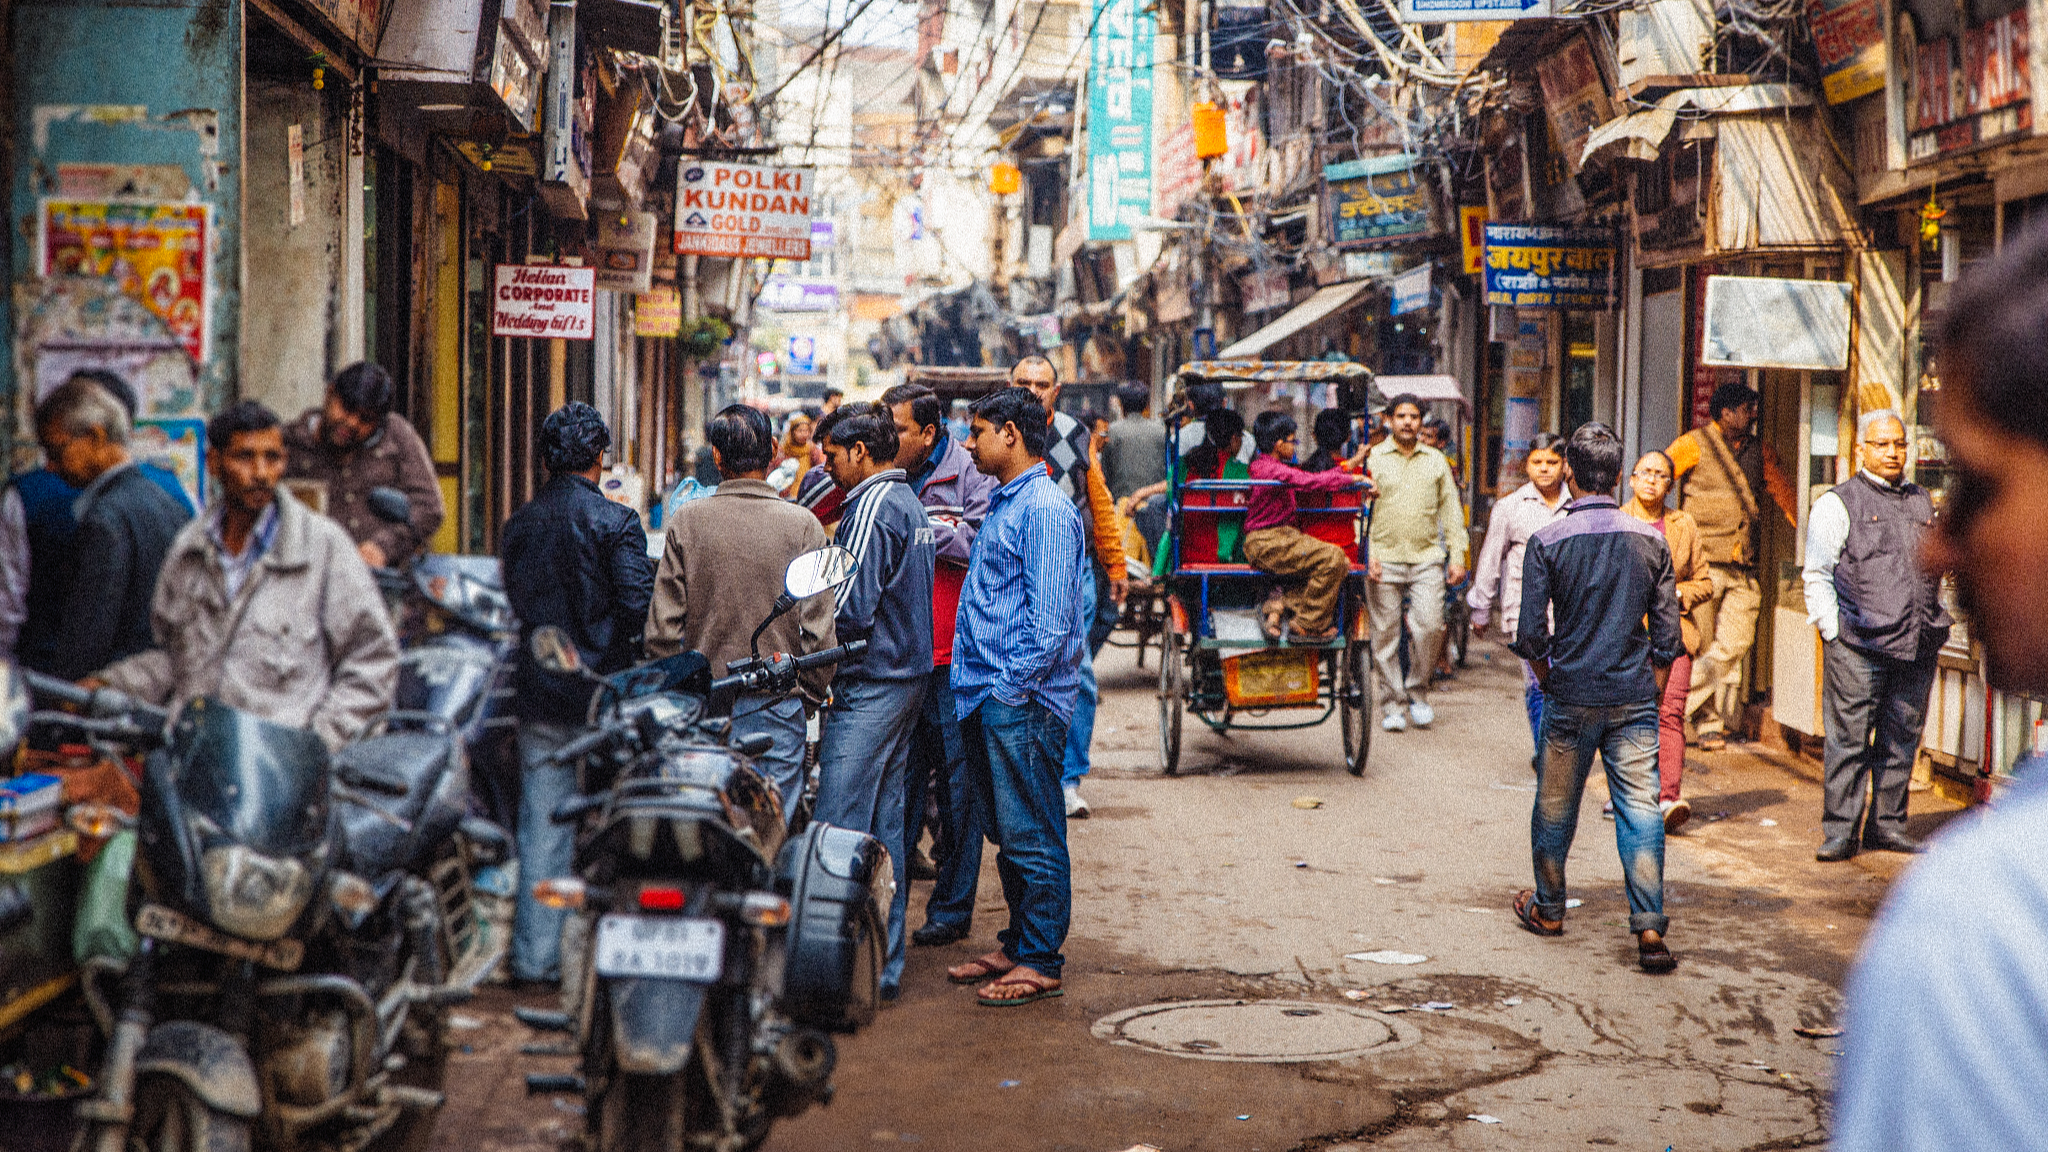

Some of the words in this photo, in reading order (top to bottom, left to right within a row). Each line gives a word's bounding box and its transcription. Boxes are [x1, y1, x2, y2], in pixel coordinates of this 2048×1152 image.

[714, 168, 802, 192] POLKI
[684, 189, 809, 215] KUNDAN
[711, 213, 761, 233] GOLD
[500, 285, 589, 303] CORPORATE
